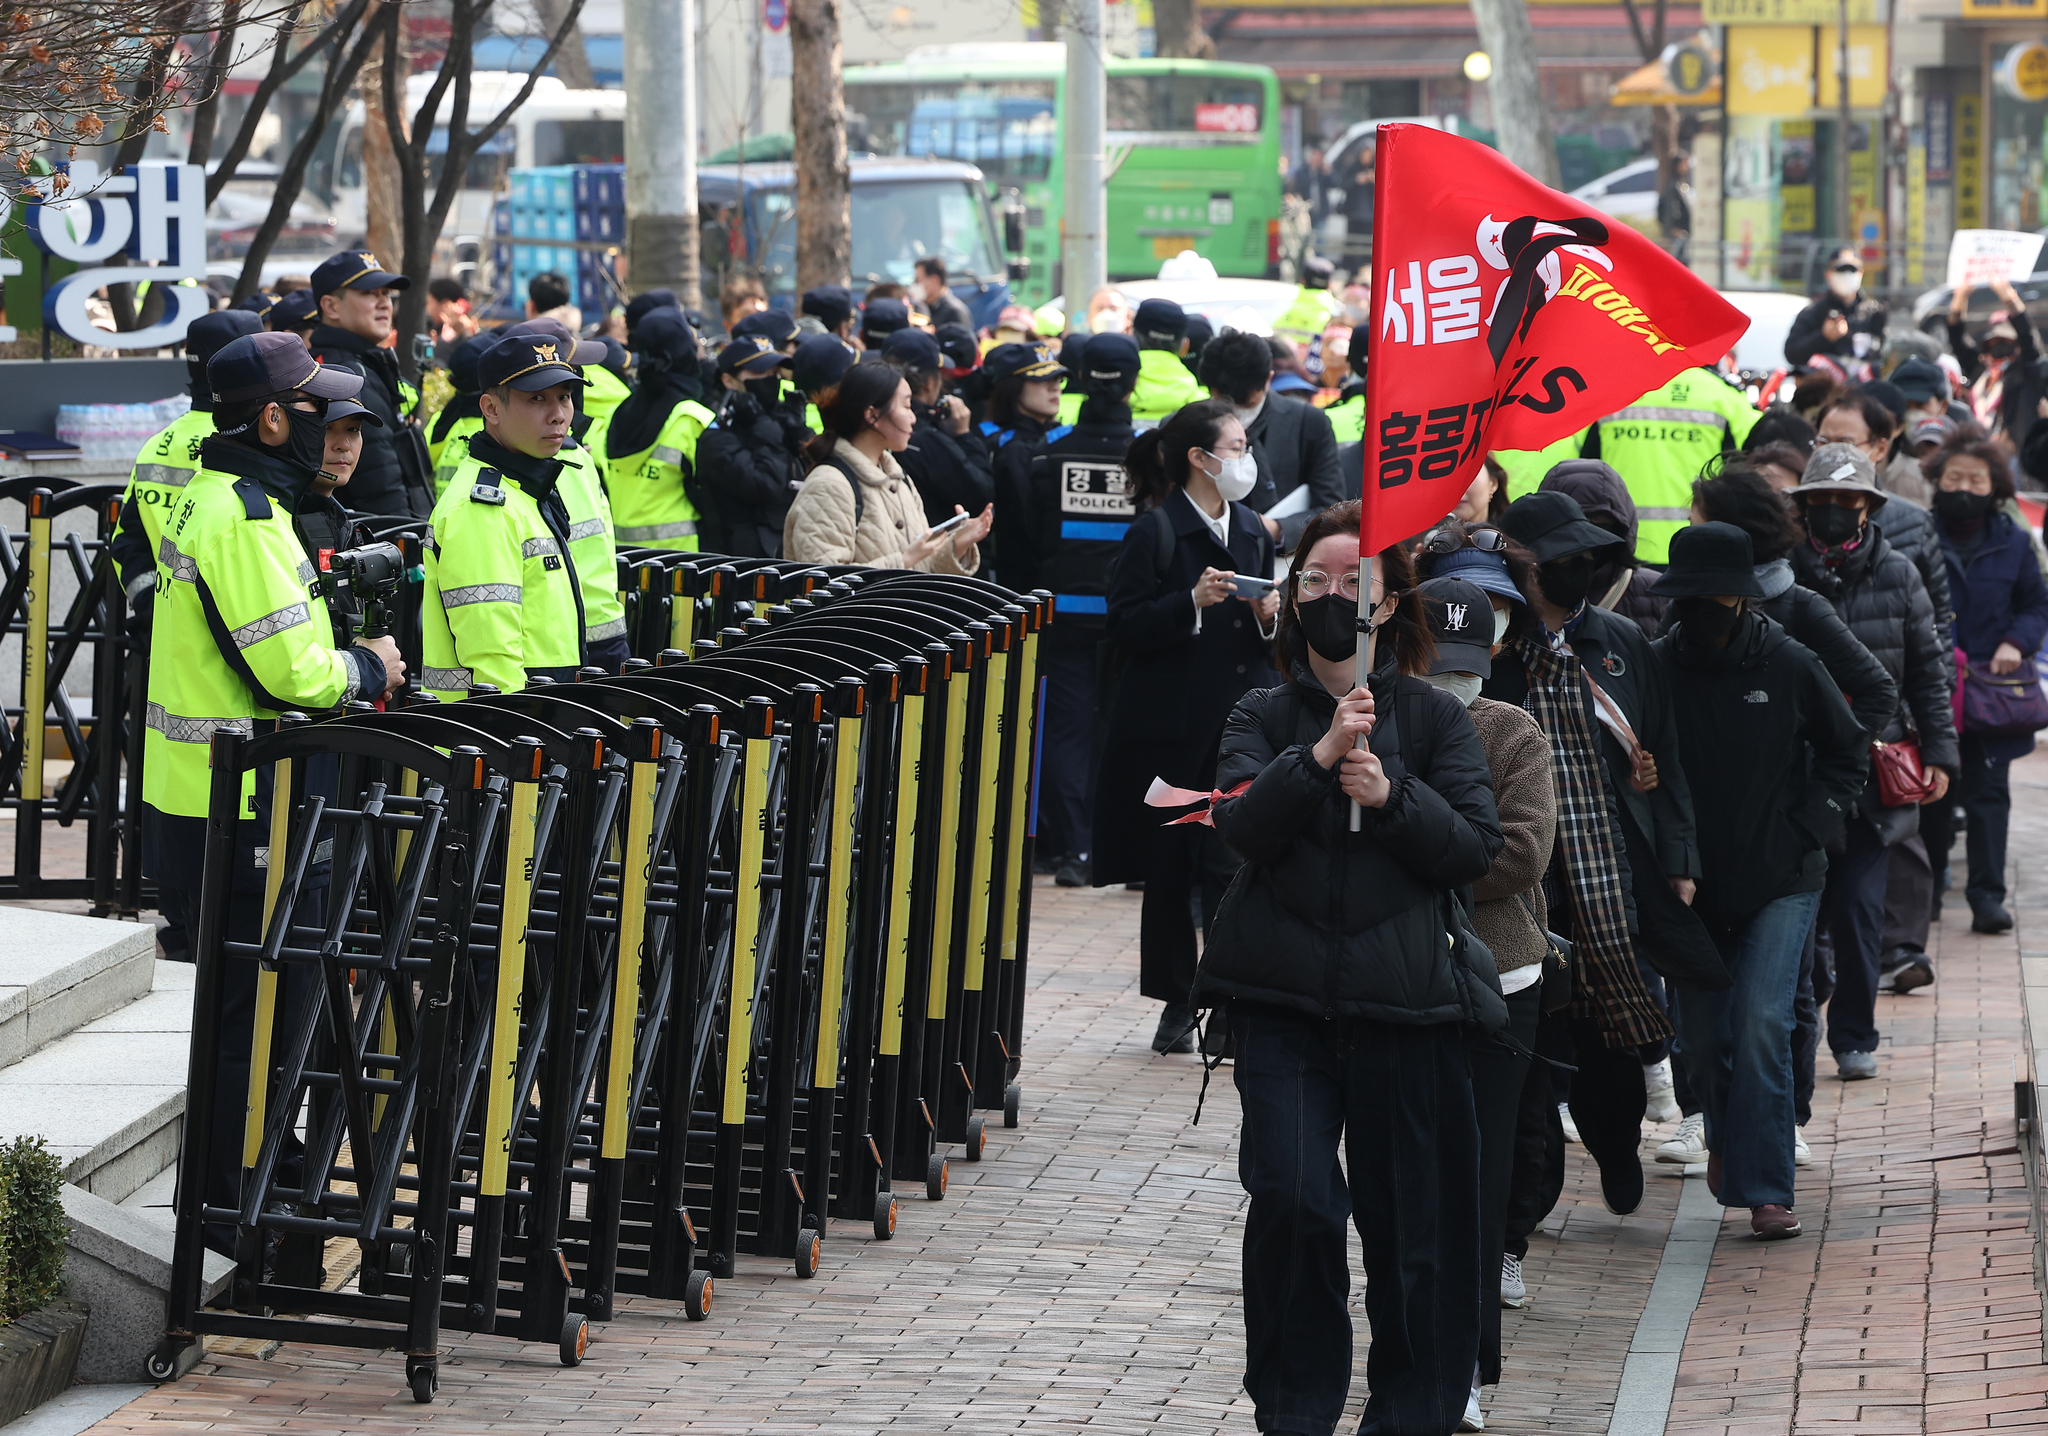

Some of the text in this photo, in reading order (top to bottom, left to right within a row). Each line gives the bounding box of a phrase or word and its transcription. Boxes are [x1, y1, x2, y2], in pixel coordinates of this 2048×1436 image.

[0, 158, 210, 349] 행
[1382, 254, 1482, 346] 서울
[1496, 356, 1588, 414] LS
[1613, 426, 1702, 443] POLICE
[1069, 496, 1128, 509] POLICE
